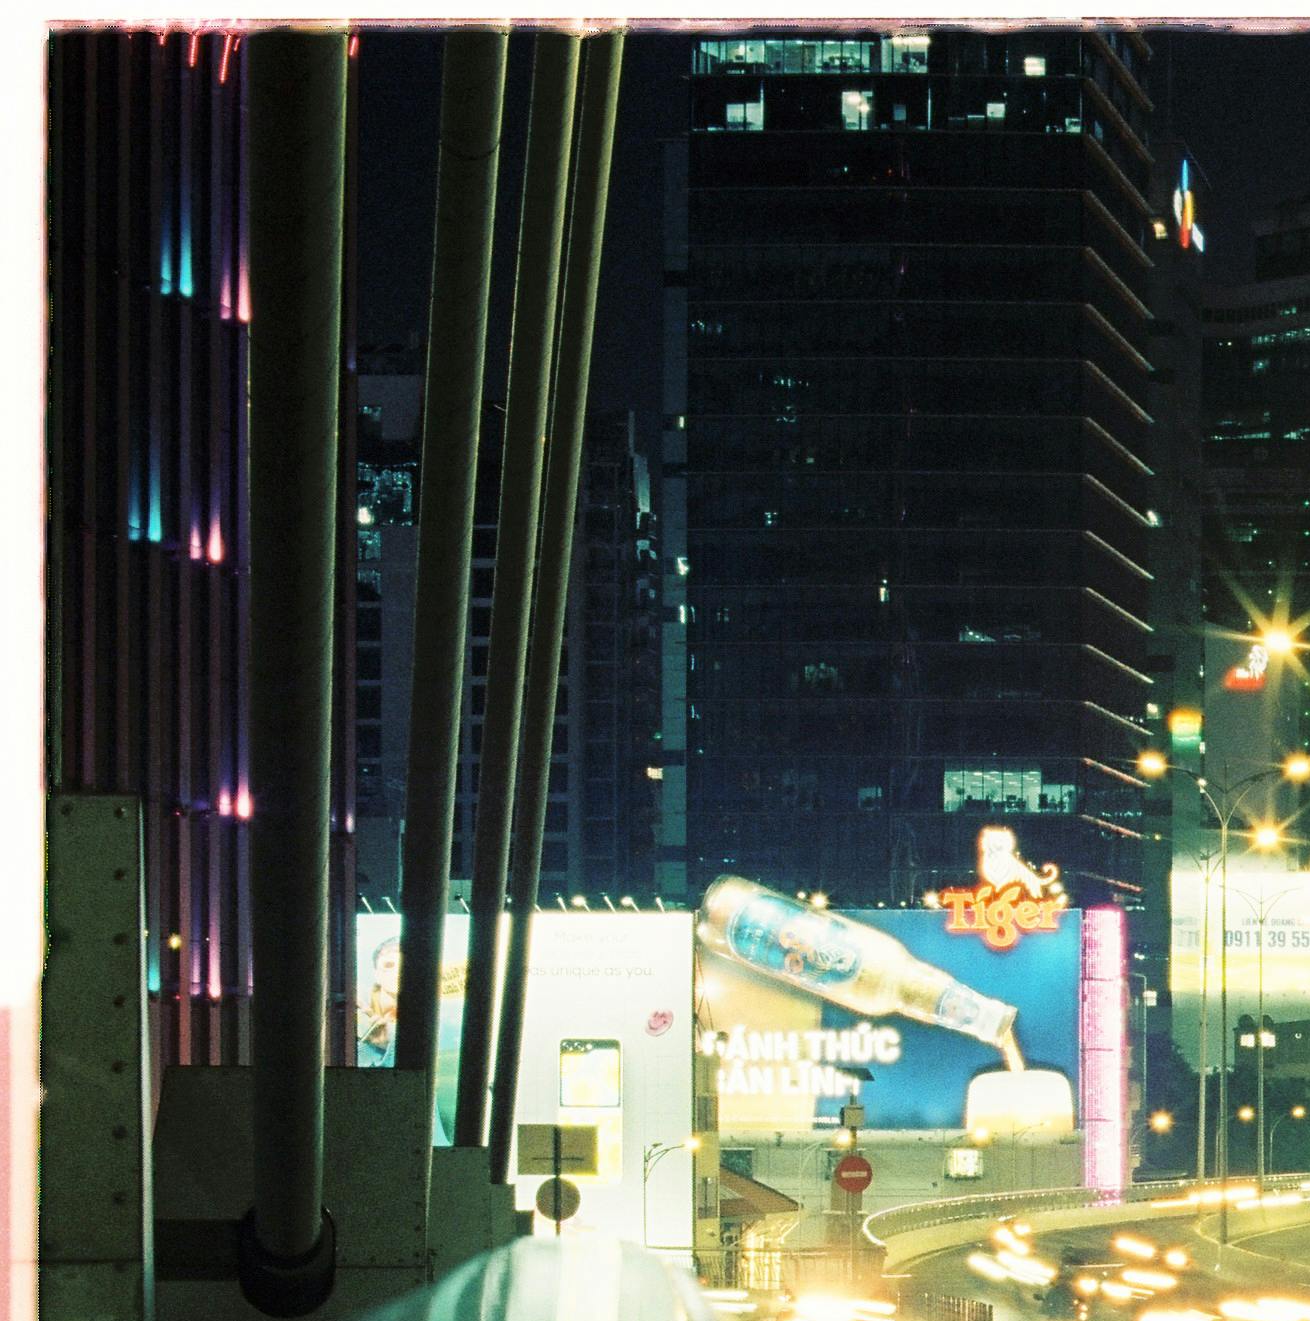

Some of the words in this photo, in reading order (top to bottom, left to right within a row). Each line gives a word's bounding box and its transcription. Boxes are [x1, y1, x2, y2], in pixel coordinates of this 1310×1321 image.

[942, 885, 1062, 948] Tiger
[1225, 930, 1261, 947] 0911
[1267, 931, 1286, 947] 39
[531, 966, 548, 977] as
[551, 965, 600, 979] unique
[604, 966, 622, 977] as
[625, 966, 656, 980] you.
[804, 1022, 901, 1065] THỨC
